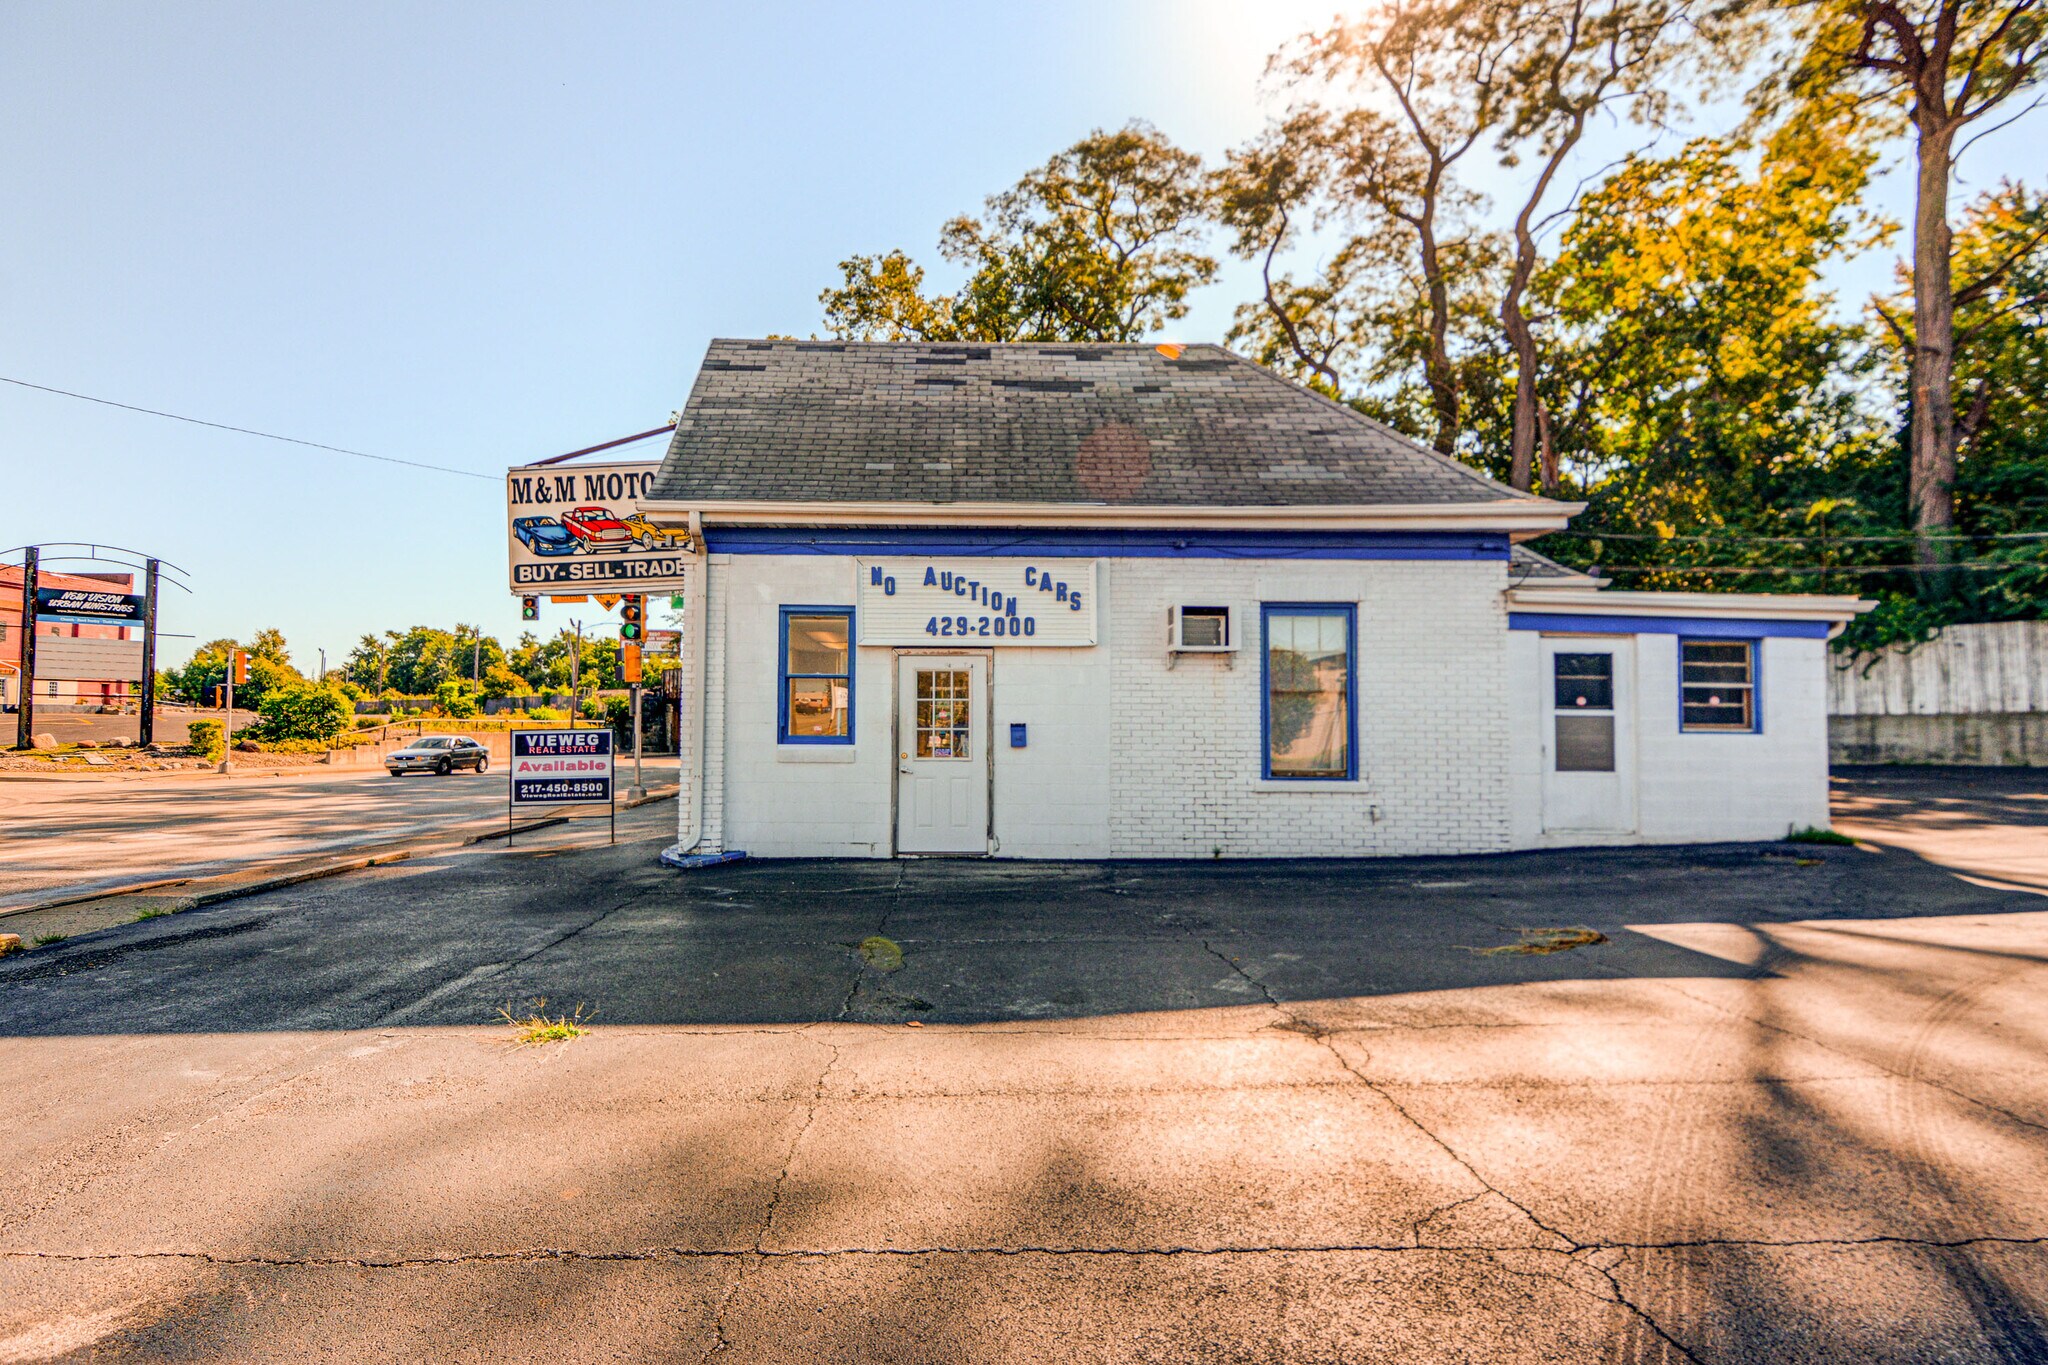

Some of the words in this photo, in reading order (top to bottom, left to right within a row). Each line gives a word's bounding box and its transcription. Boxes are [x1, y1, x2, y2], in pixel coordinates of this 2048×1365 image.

[512, 476, 576, 504] M&M
[61, 591, 86, 600] NEW
[87, 595, 124, 603] VISION
[871, 567, 895, 595] NO
[924, 567, 1017, 616] AUCTION
[1025, 567, 1081, 611] CARS
[48, 599, 82, 608] URBAN
[81, 603, 135, 612] MINISTRIES
[526, 734, 598, 746] VIEWEG
[518, 761, 606, 771] Available
[521, 783, 603, 792] 217-450-8500
